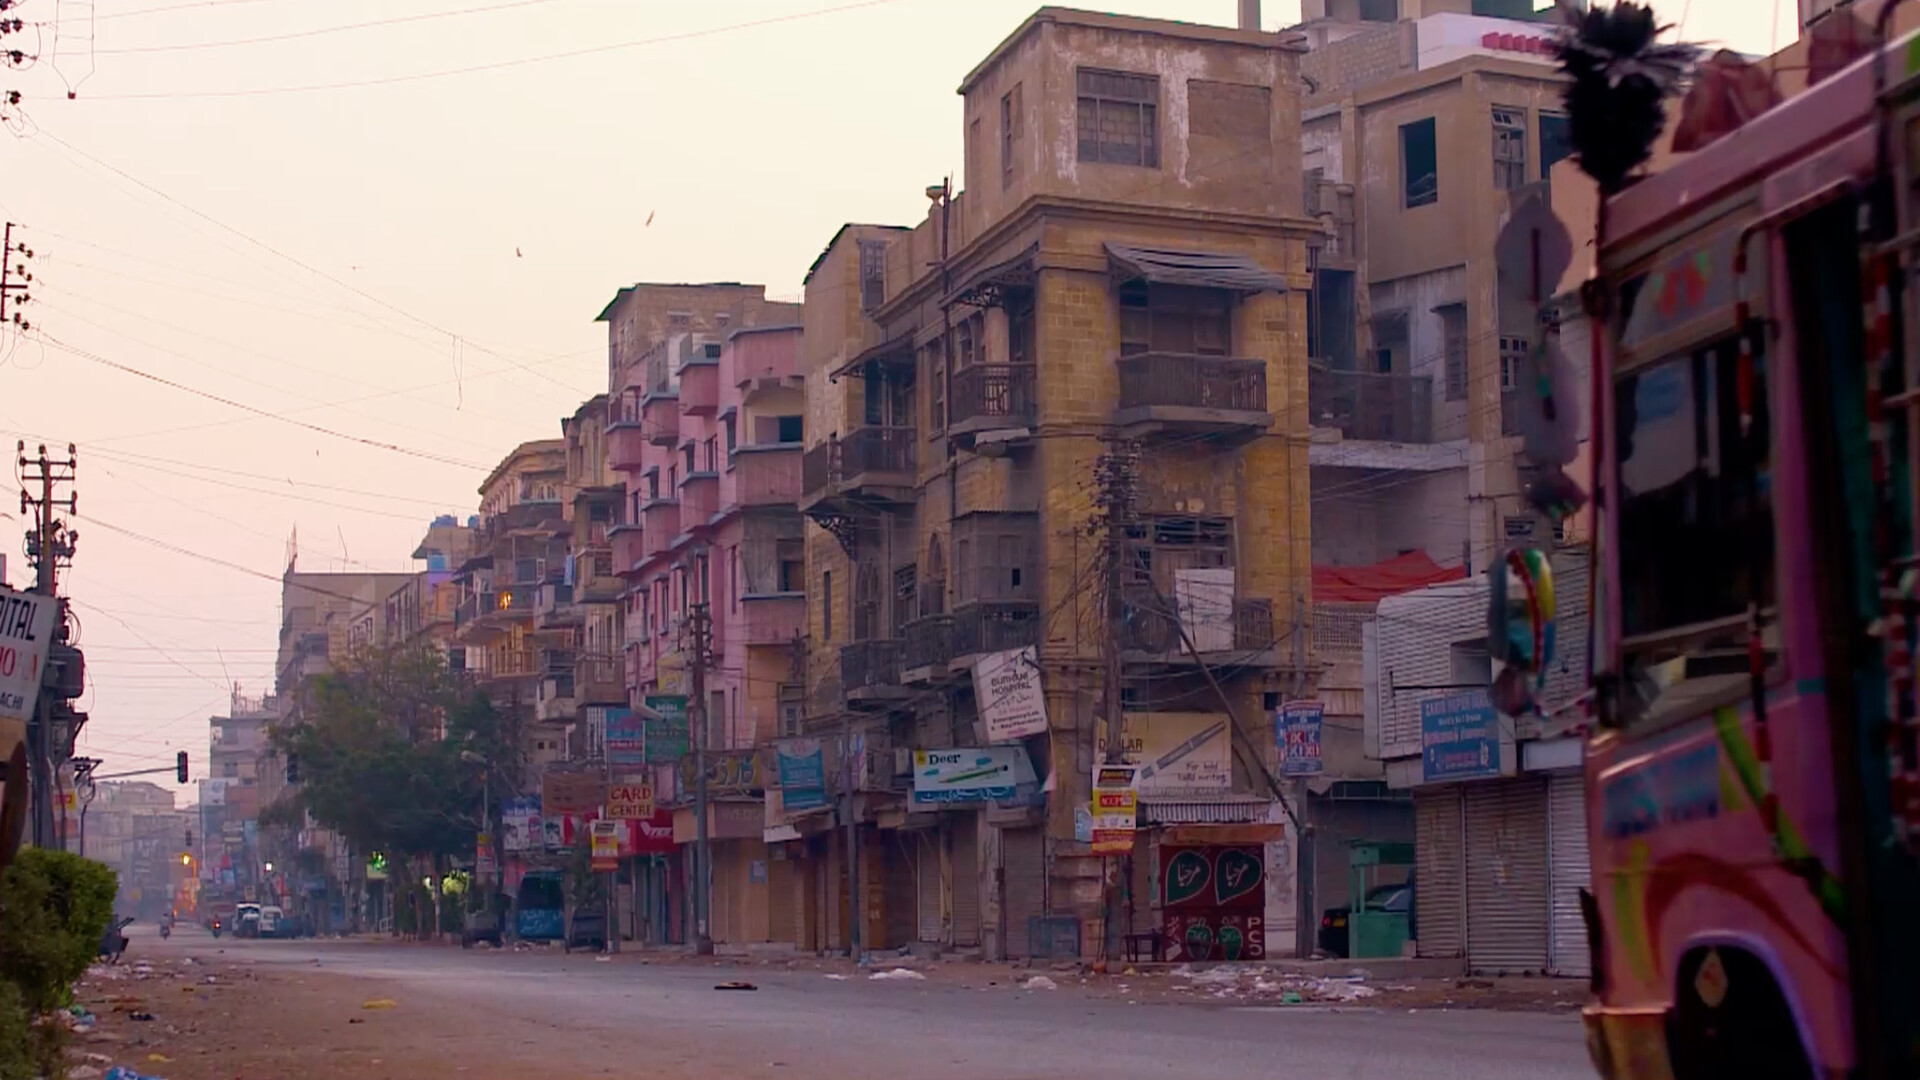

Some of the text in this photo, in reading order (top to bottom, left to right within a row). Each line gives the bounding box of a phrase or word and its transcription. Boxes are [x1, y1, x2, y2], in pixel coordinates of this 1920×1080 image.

[1099, 738, 1143, 749] DLAR
[929, 754, 961, 765] Deer
[1186, 762, 1199, 770] For
[611, 787, 652, 802] CARD
[611, 804, 652, 816] CENTRE
